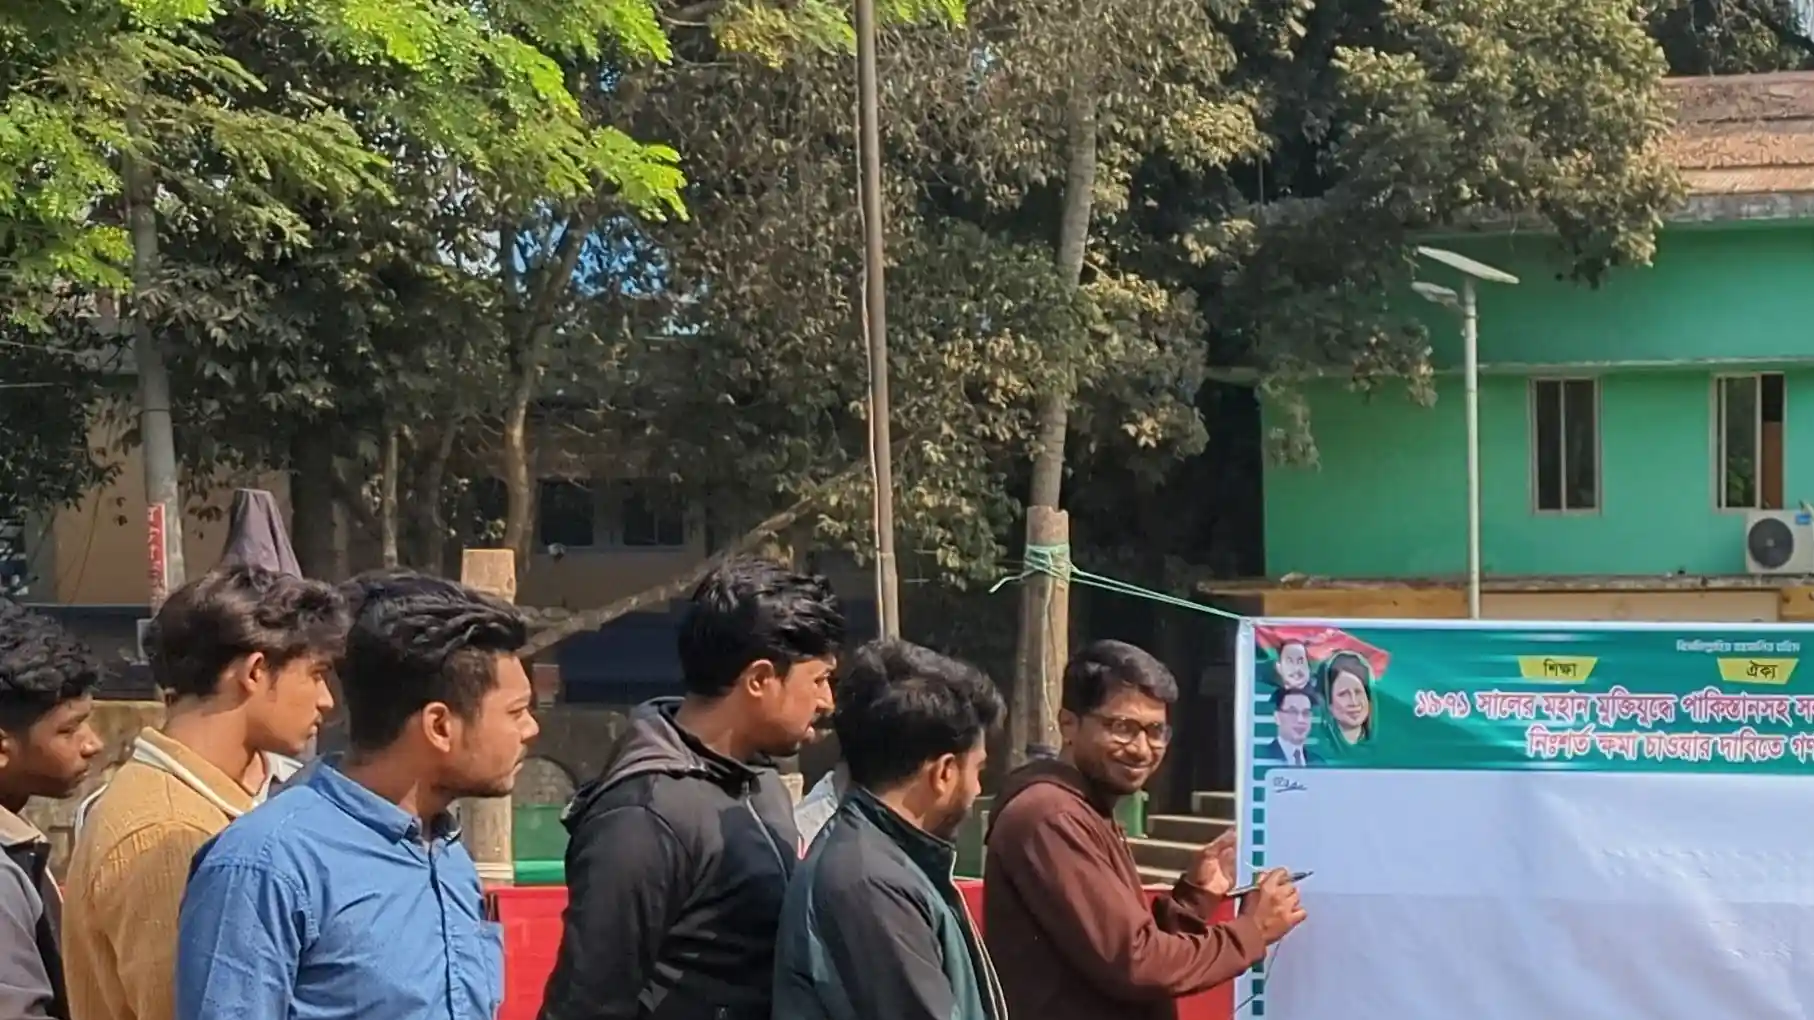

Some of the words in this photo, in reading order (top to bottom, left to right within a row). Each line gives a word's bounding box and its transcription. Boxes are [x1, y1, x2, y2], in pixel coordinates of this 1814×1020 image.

[1543, 657, 1578, 676] শিক্ষা
[1746, 660, 1779, 679] ঐক্য
[1474, 688, 1537, 720] সালের
[1541, 689, 1590, 722] মহান
[1595, 685, 1677, 728] মুক্তিযুদ্ধে
[1680, 685, 1793, 728] পাকিস্তানসহ
[1525, 723, 1595, 759] নিঃশর্ত
[1595, 731, 1638, 760] ক্ষমা
[1642, 730, 1714, 762] চাওয়ার
[1718, 725, 1786, 763] দাবিতে
